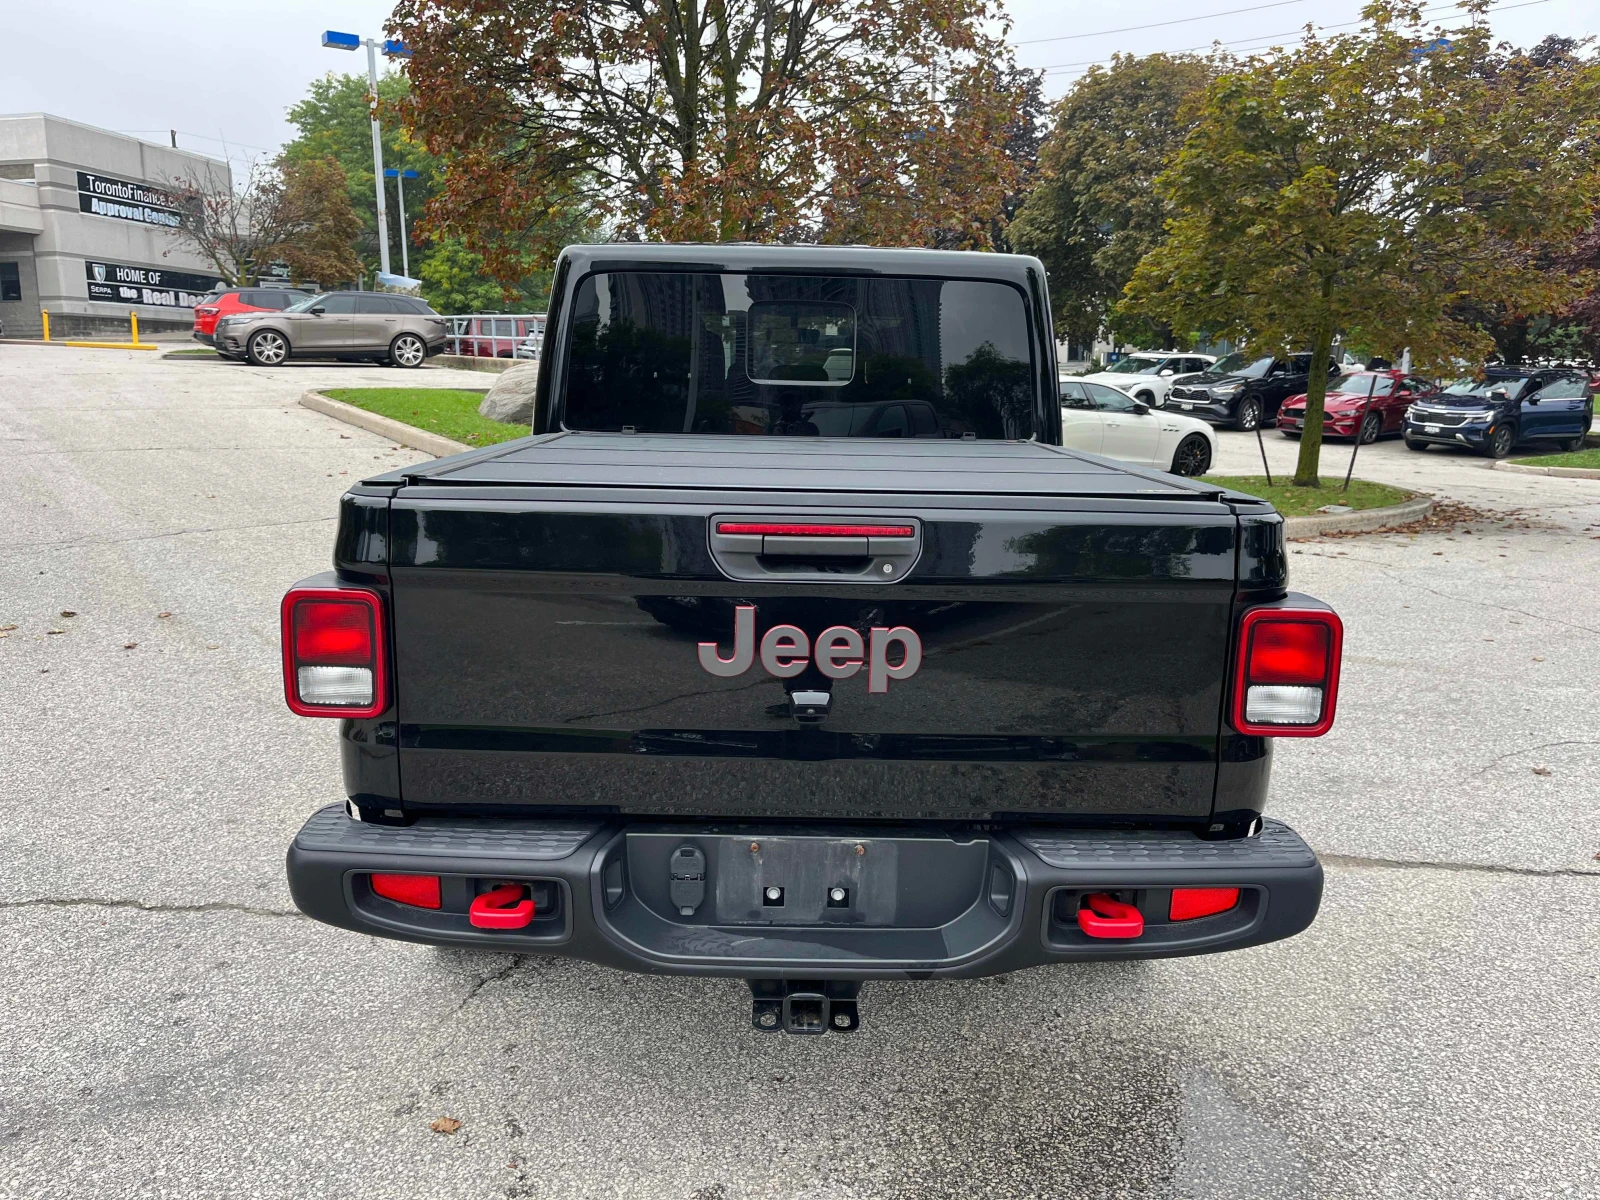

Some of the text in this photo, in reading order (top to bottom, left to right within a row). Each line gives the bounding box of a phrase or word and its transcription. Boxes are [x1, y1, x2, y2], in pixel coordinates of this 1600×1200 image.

[91, 197, 144, 221] Approval
[116, 267, 162, 285] HOME OF
[90, 285, 112, 294] SERPA
[119, 286, 208, 308] the Real Dea
[697, 605, 922, 693] Jeep
